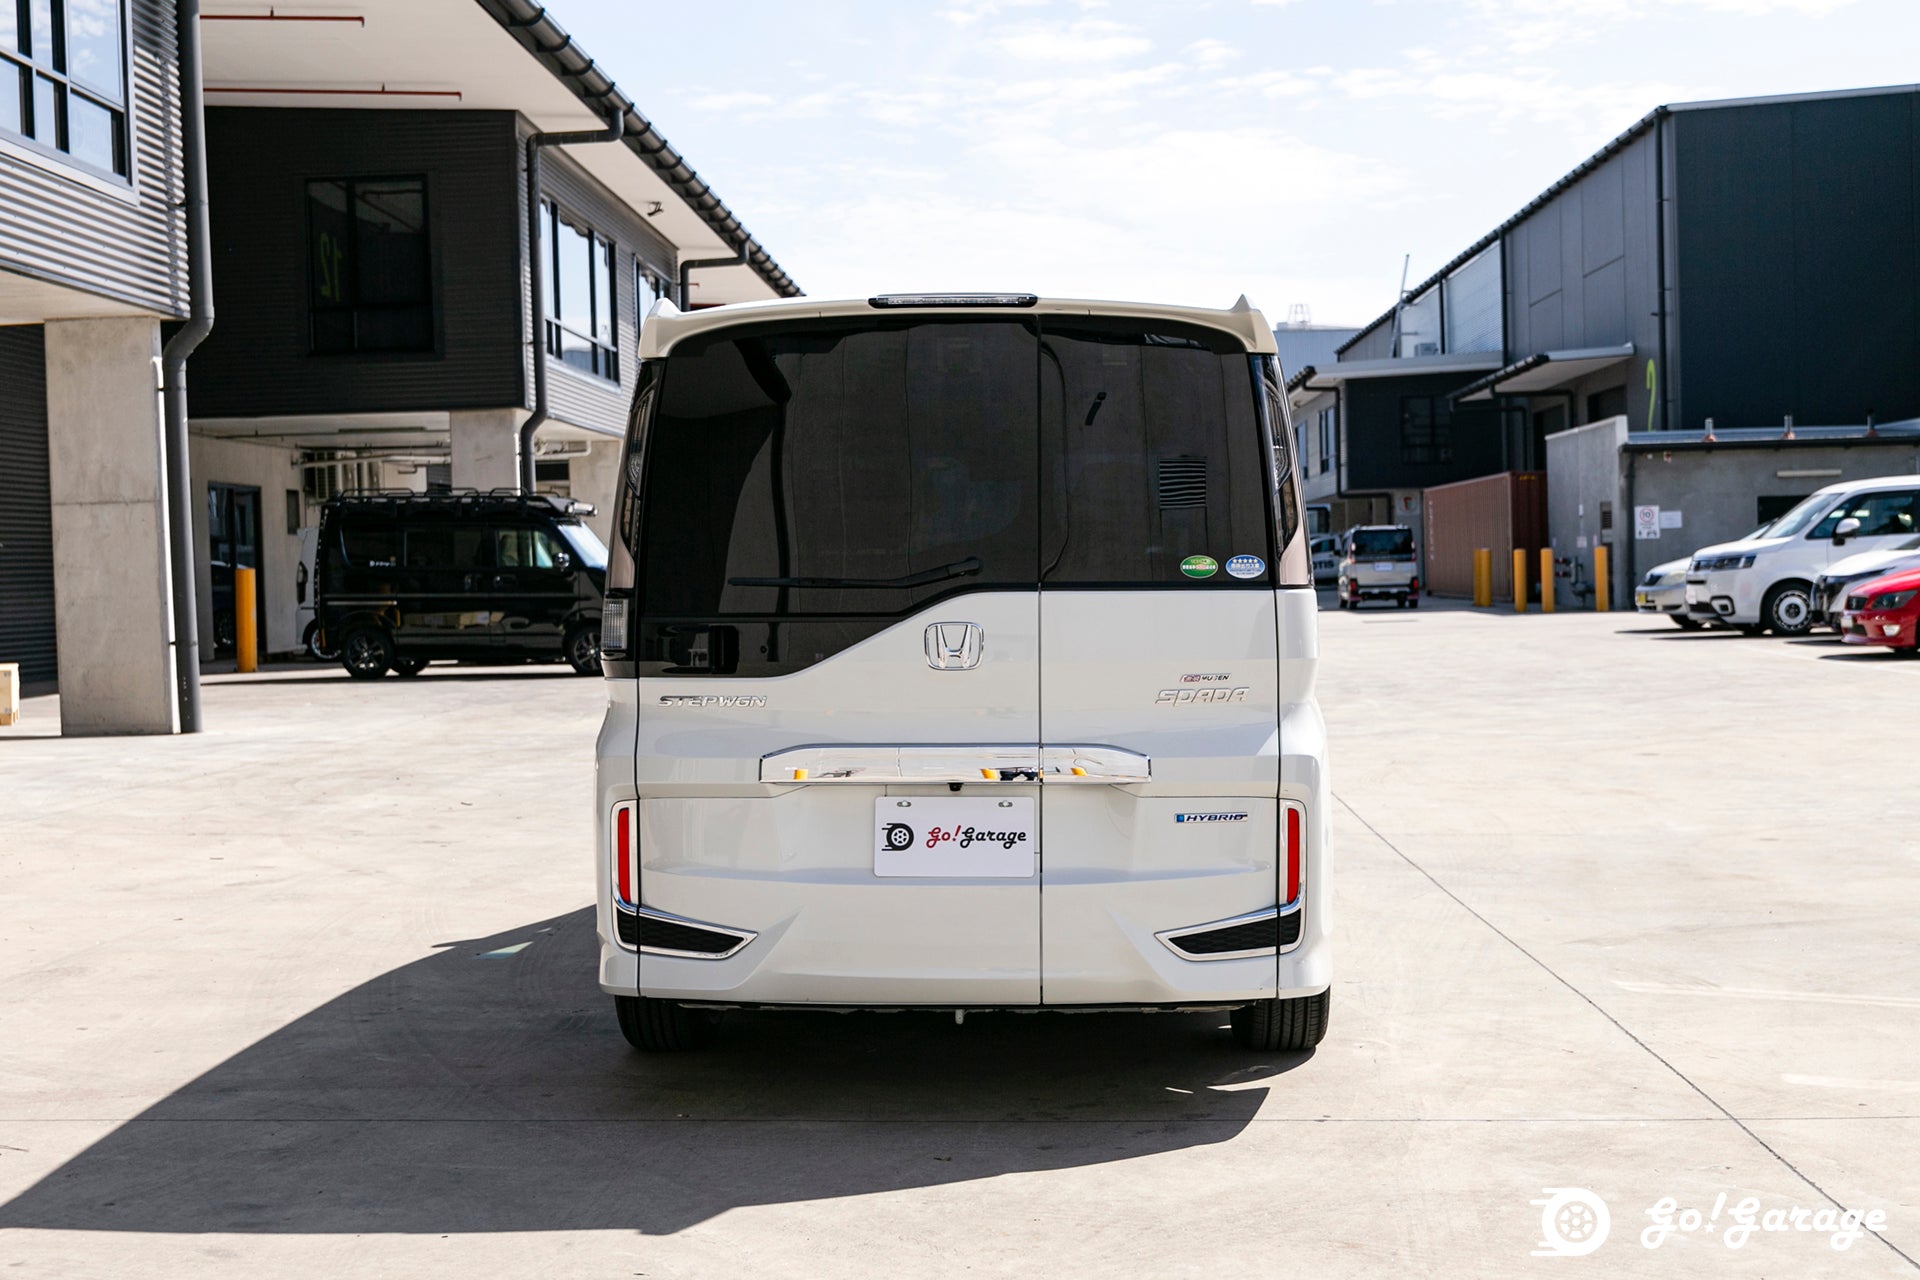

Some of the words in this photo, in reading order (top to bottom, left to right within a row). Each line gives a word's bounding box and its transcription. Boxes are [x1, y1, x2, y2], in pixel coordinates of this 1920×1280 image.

[659, 695, 768, 708] STEPWGN
[1155, 687, 1250, 706] SPADA
[1186, 813, 1248, 822] HYBRID
